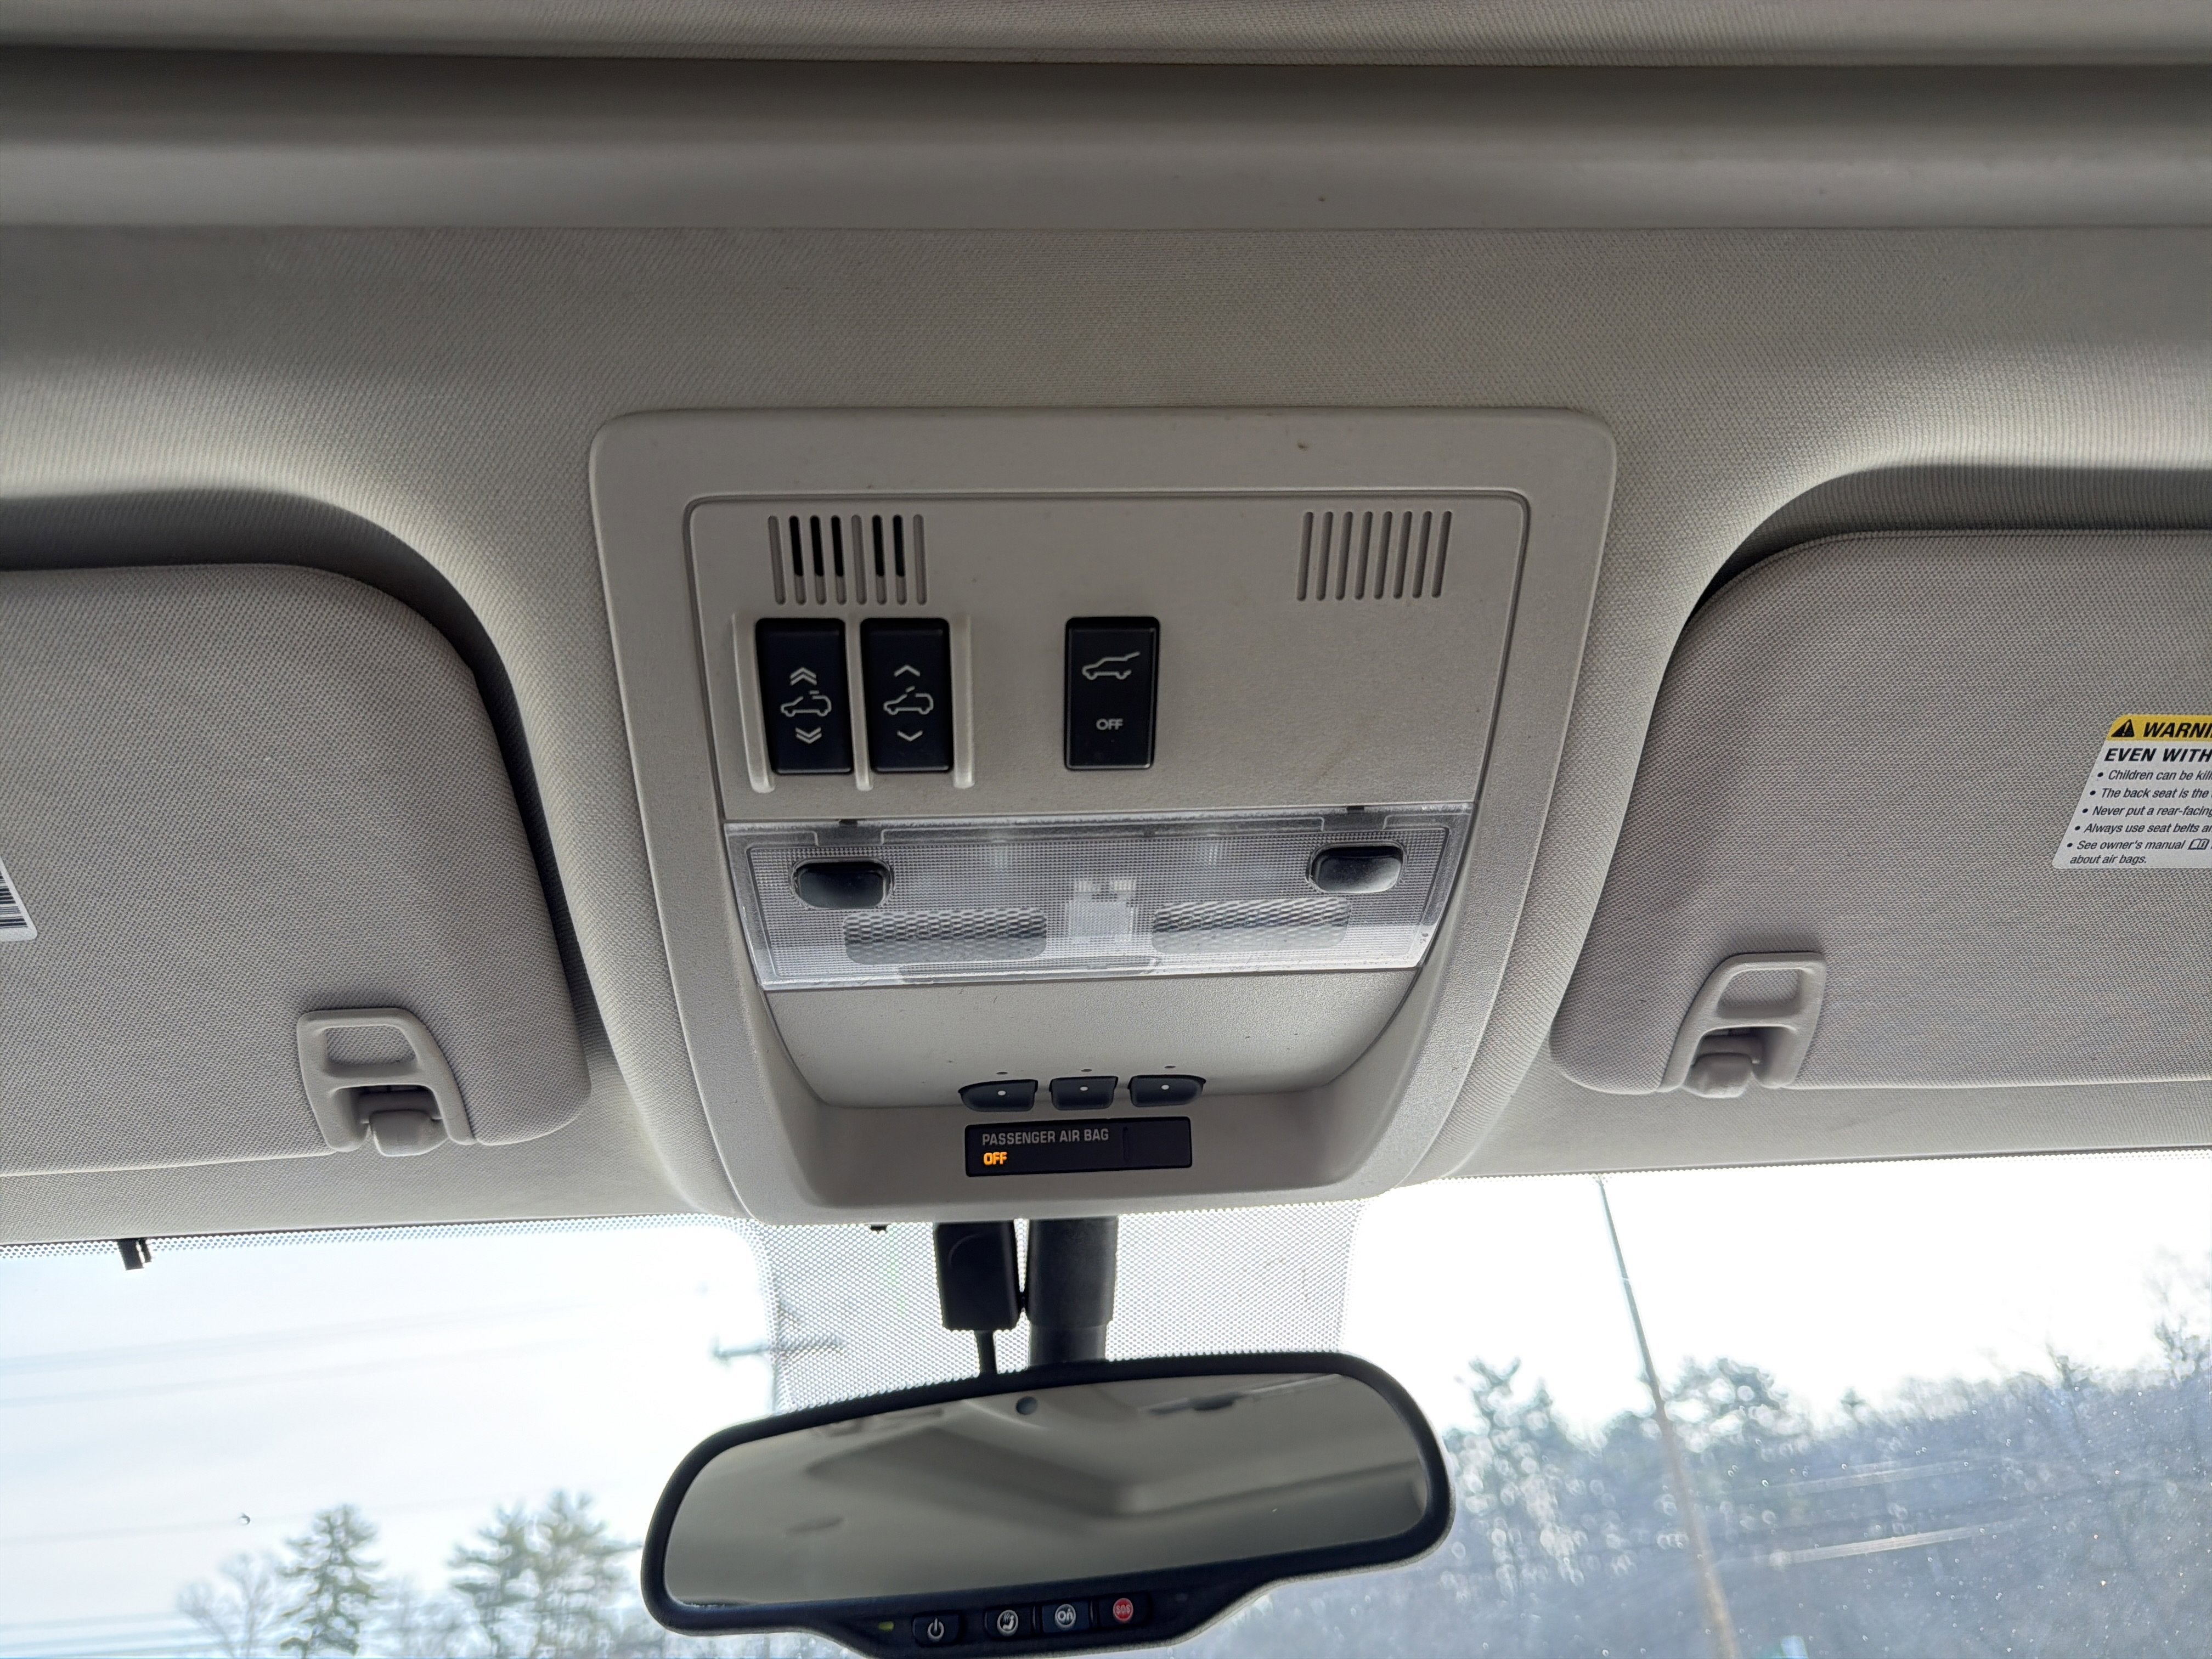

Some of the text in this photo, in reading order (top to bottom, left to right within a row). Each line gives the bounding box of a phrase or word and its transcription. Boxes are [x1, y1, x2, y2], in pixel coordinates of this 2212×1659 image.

[1096, 718, 1124, 730] OFF
[2143, 722, 2212, 738] WARNI
[2104, 748, 2212, 762] EVEN WITH
[2108, 769, 2212, 780] Children can be kill
[2101, 788, 2121, 798] The
[2123, 788, 2151, 798] back
[2152, 788, 2177, 798] seat
[2178, 788, 2189, 798] is
[2191, 788, 2209, 798] the
[2092, 805, 2125, 815] Never
[2125, 806, 2146, 817] put
[2084, 823, 2123, 834] Always
[2147, 823, 2172, 833] seat
[2172, 823, 2200, 833] belts
[2076, 840, 2186, 850] See owner's manual
[2069, 854, 2147, 865] about air bags.
[982, 1128, 1109, 1146] PASSENGER AIR BAG
[984, 1152, 1007, 1165] OFF
[1115, 1604, 1131, 1616] SOS
